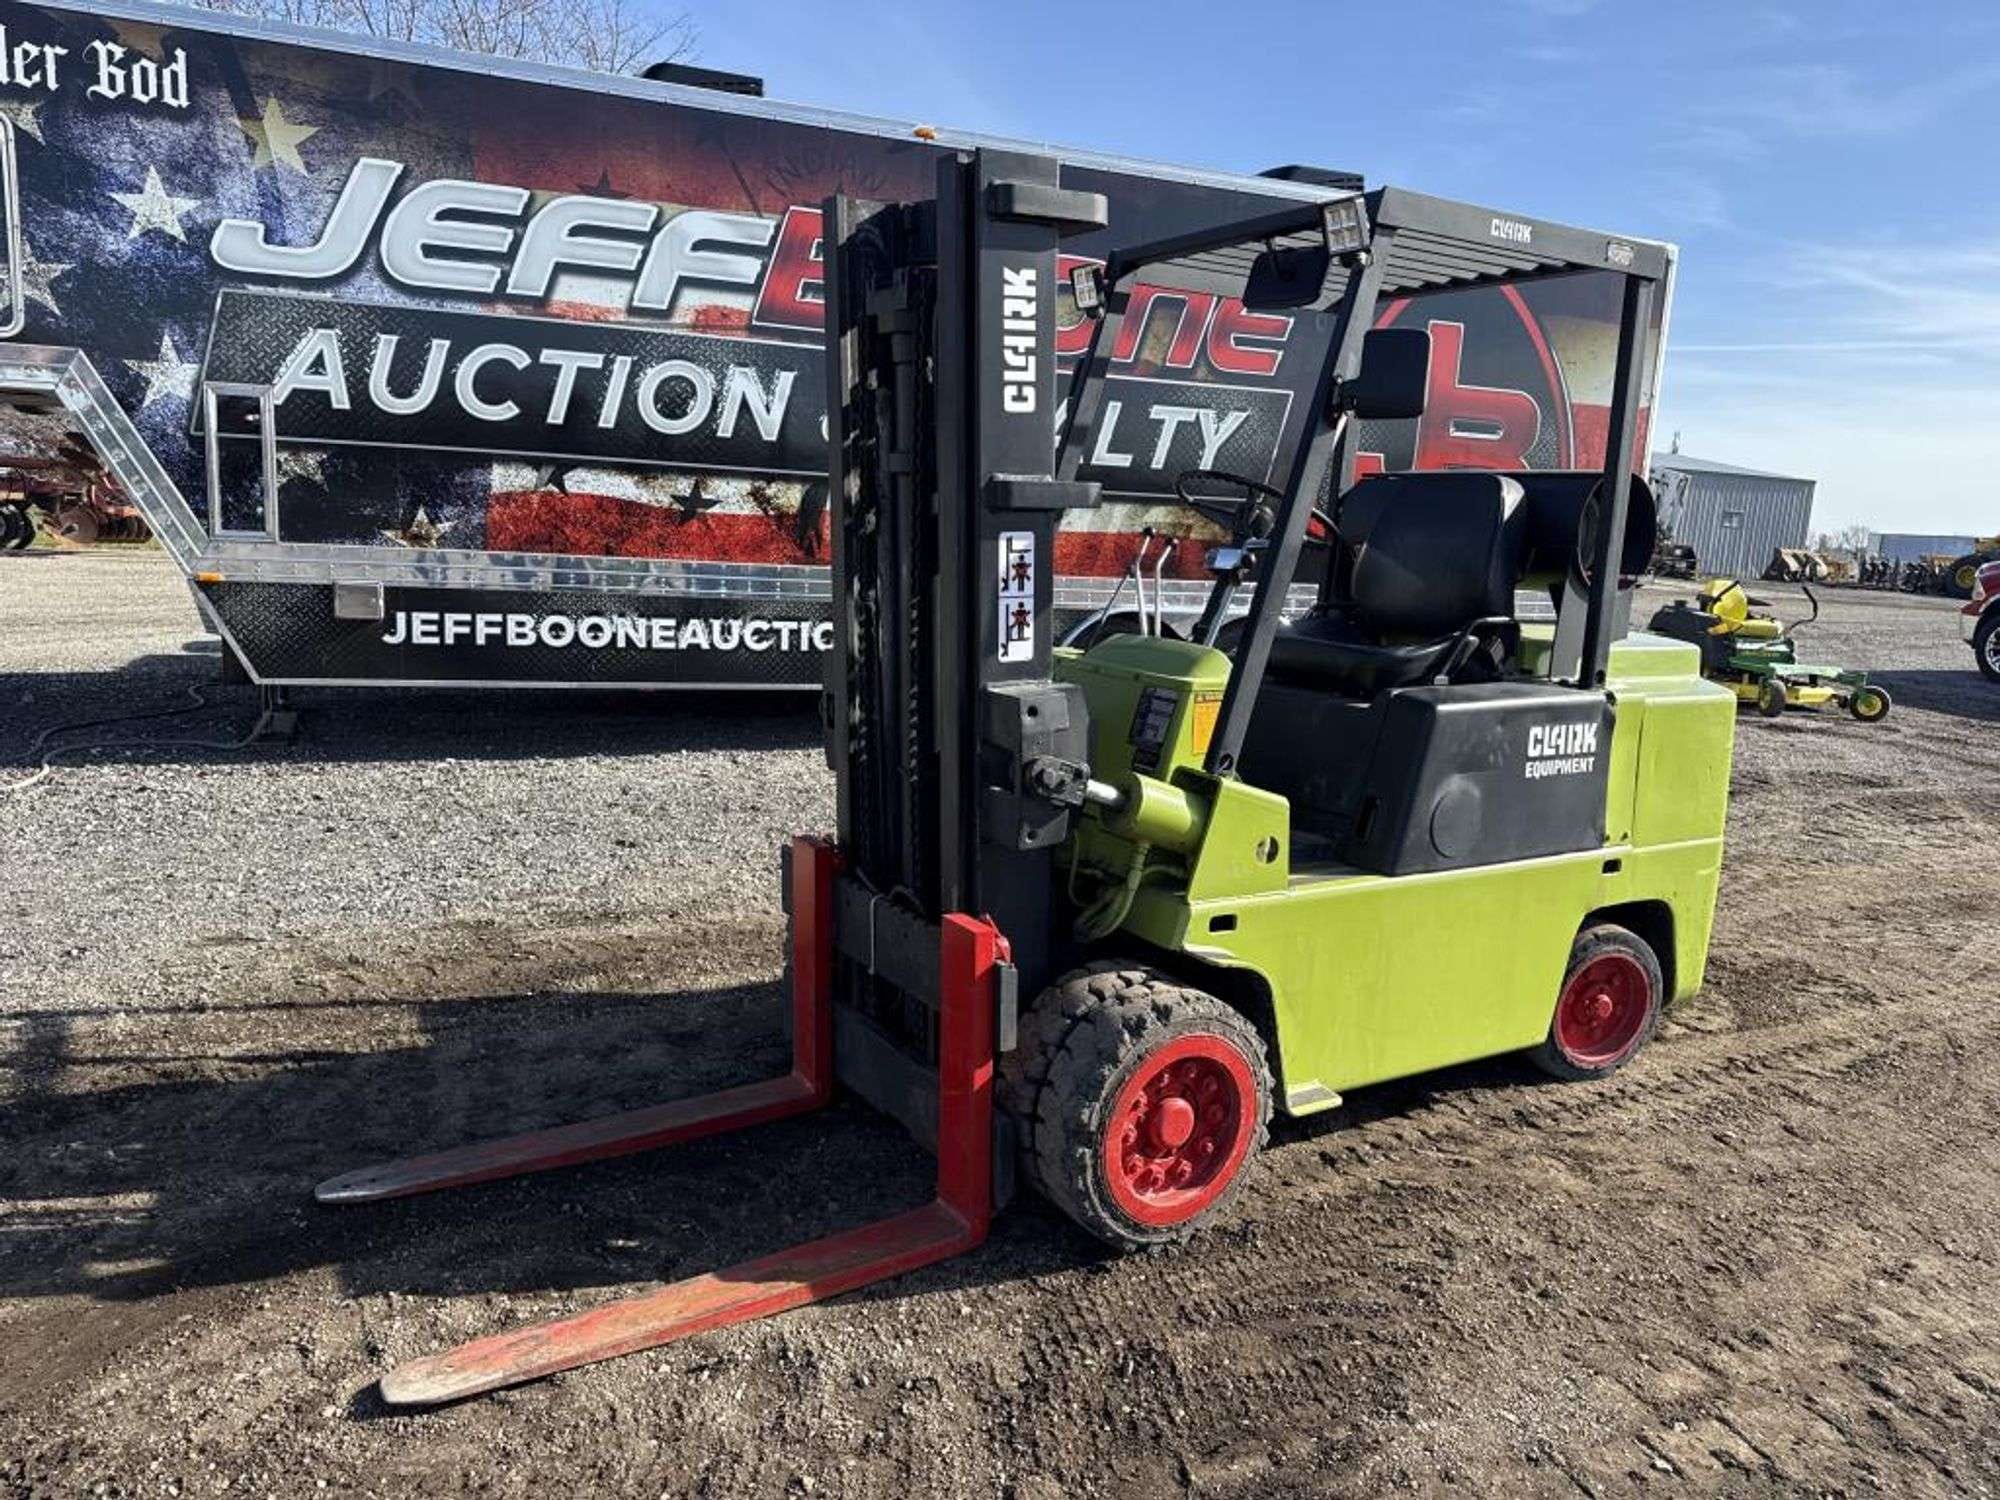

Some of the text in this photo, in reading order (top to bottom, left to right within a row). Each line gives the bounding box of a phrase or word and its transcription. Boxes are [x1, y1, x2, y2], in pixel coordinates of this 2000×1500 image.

[1003, 267, 1037, 413] CLARK
[274, 328, 798, 442] AUCTION
[1525, 757, 1595, 779] EQUIPMENT
[1527, 722, 1598, 757] CLARK
